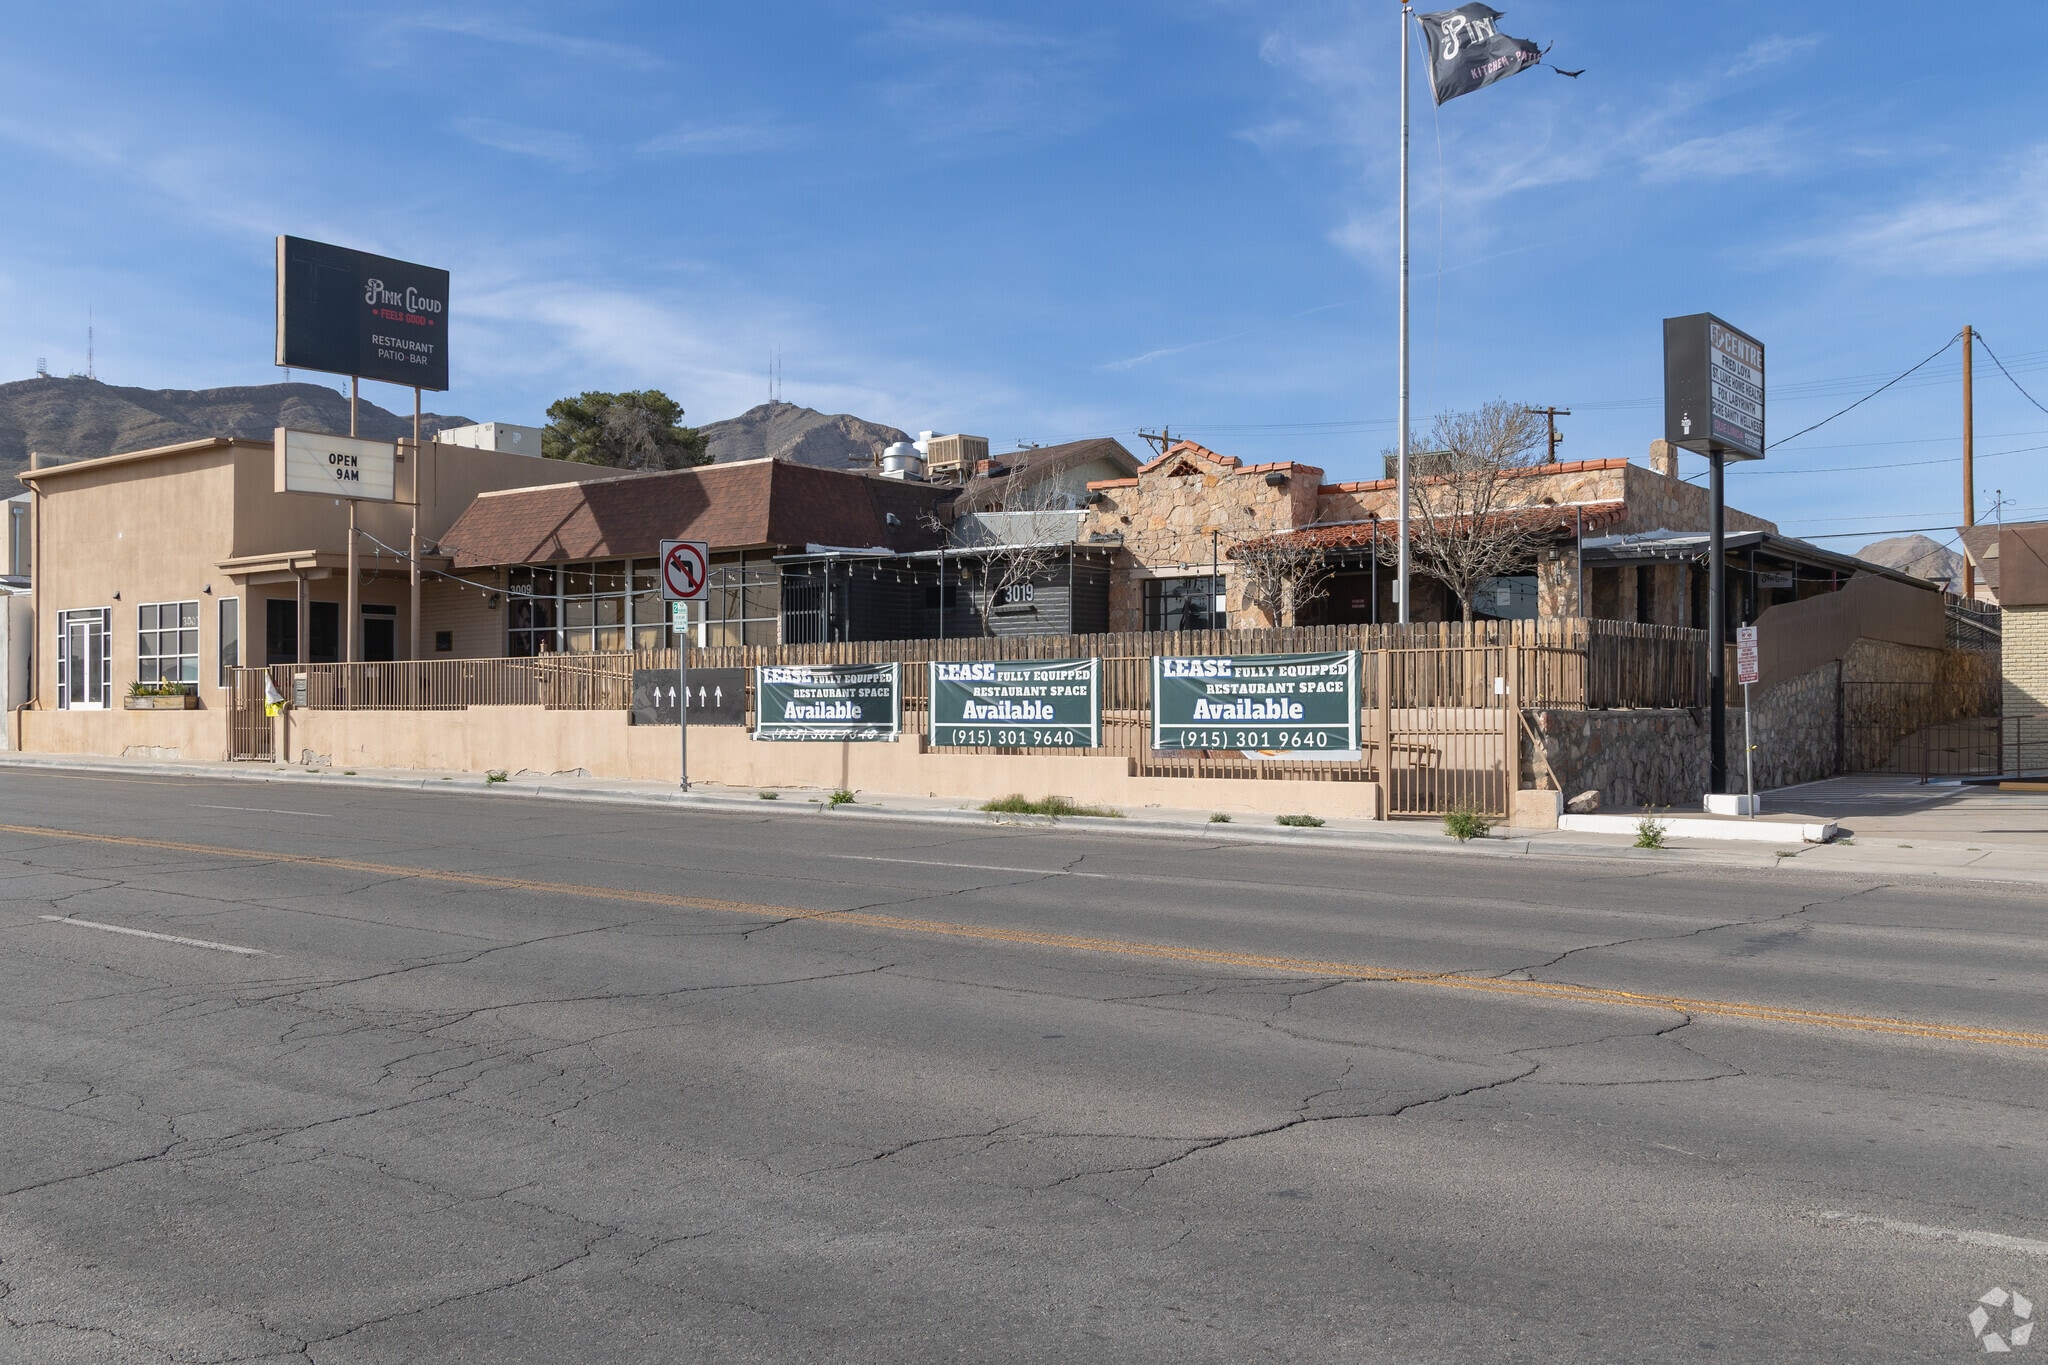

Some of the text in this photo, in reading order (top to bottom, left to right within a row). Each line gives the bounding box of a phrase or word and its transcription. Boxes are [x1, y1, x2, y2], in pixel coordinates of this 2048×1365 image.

[1471, 56, 1509, 79] KITCHEN
[381, 309, 425, 326] FEELS GOOD
[372, 334, 434, 353] RESTAURANT
[1725, 332, 1762, 368] CENTRE
[1722, 355, 1751, 380] FRED LOYA
[1720, 372, 1731, 388] LUKE
[1732, 377, 1745, 394] HOME
[1746, 383, 1762, 402] HEALTH
[1718, 387, 1756, 414] FOX LABYRINTH
[1712, 401, 1762, 434] PURE SANITY WELLNESS
[329, 453, 357, 467] OPEN
[337, 468, 359, 481] 9AM
[511, 584, 532, 595] 3009
[1005, 584, 1033, 602] 3019
[764, 669, 892, 684] LEASE FULLY EQUIPPED
[938, 664, 1090, 681] LEASE FULLY EQUIPPED
[1163, 659, 1347, 678] LEASE FULLY EQUIPPED
[794, 688, 889, 697] RESTAURANT SPACE
[973, 686, 1087, 696] RESTAURANT SPACE
[1207, 682, 1343, 694] RESTAURANT SPACE
[784, 701, 861, 719] Available
[963, 700, 1053, 719] Available
[1193, 698, 1303, 719] Available
[953, 729, 1073, 745] (915) 301 9640
[1181, 731, 1327, 749] (915) 301 9640
